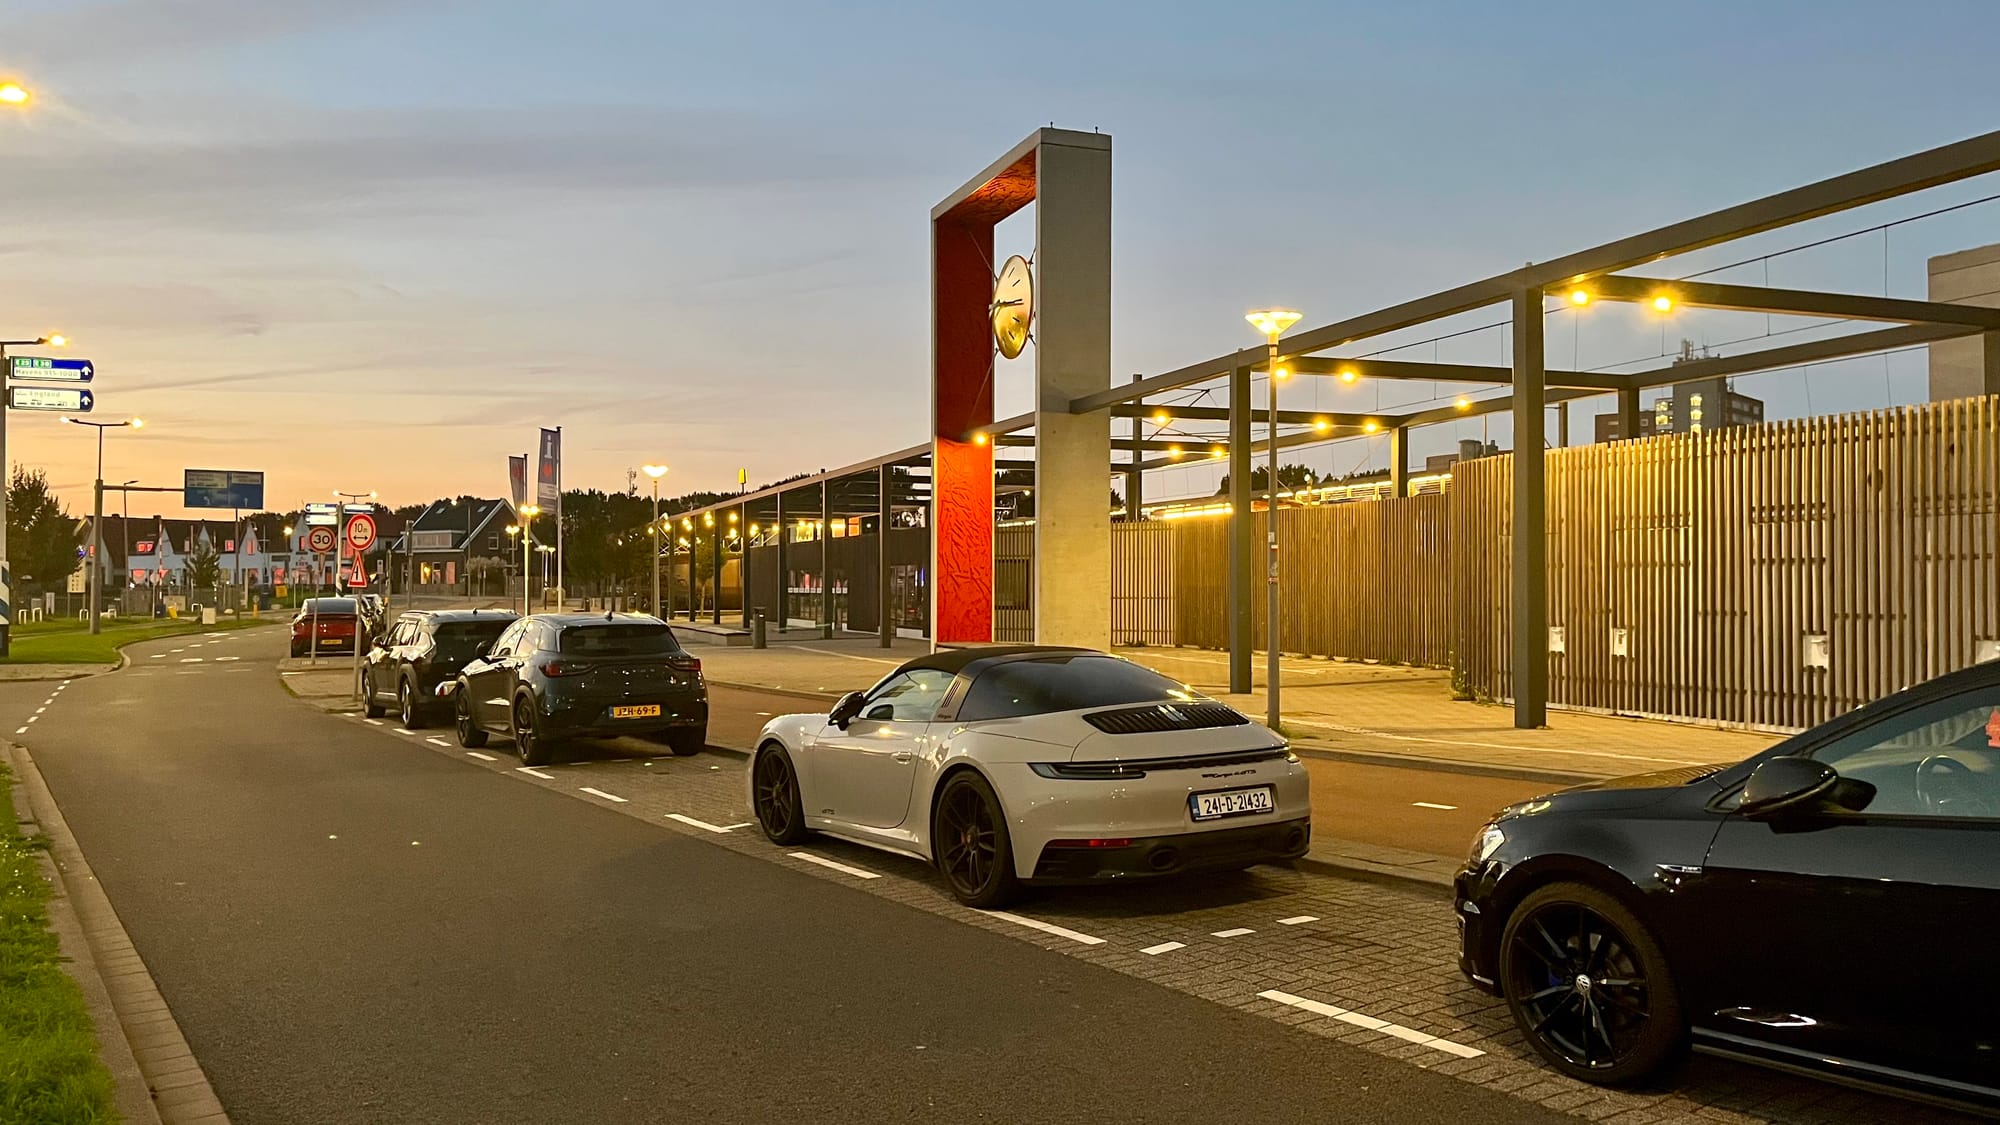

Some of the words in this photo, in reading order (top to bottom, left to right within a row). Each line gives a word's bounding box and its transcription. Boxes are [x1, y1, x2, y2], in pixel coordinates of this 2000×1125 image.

[30, 390, 61, 398] England
[314, 535, 330, 545] 30
[1204, 793, 1267, 814] 241-D-21432
